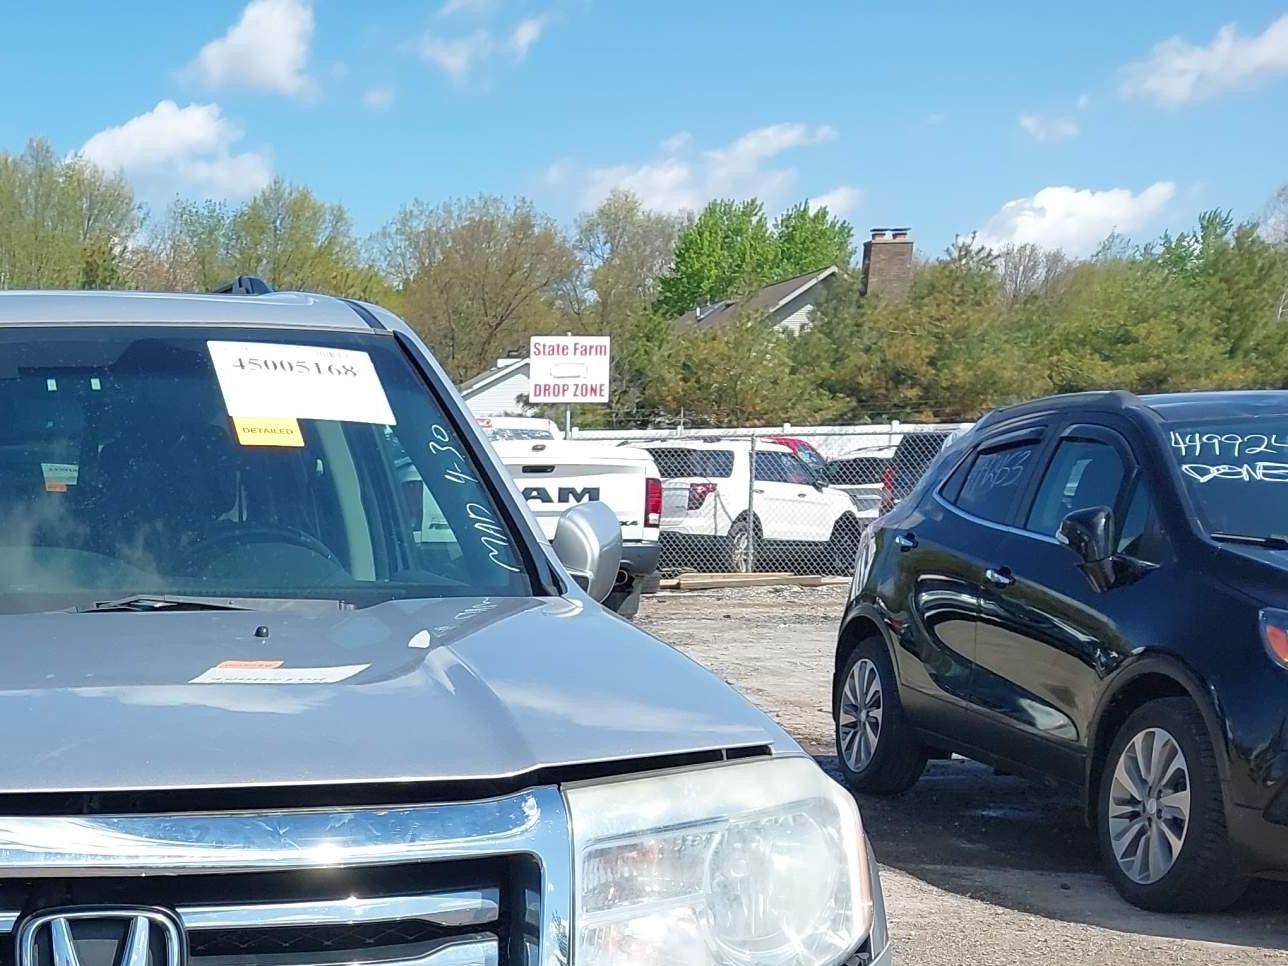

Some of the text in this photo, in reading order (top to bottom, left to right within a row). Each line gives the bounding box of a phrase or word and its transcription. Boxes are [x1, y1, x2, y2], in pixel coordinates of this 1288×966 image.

[533, 342, 607, 356] State Farm
[232, 357, 357, 377] 45005168
[533, 383, 605, 397] DROP ZONE
[242, 426, 294, 435] DETAILED
[428, 424, 480, 483] 4-30
[1181, 462, 1288, 482] DONE
[521, 487, 600, 504] AM
